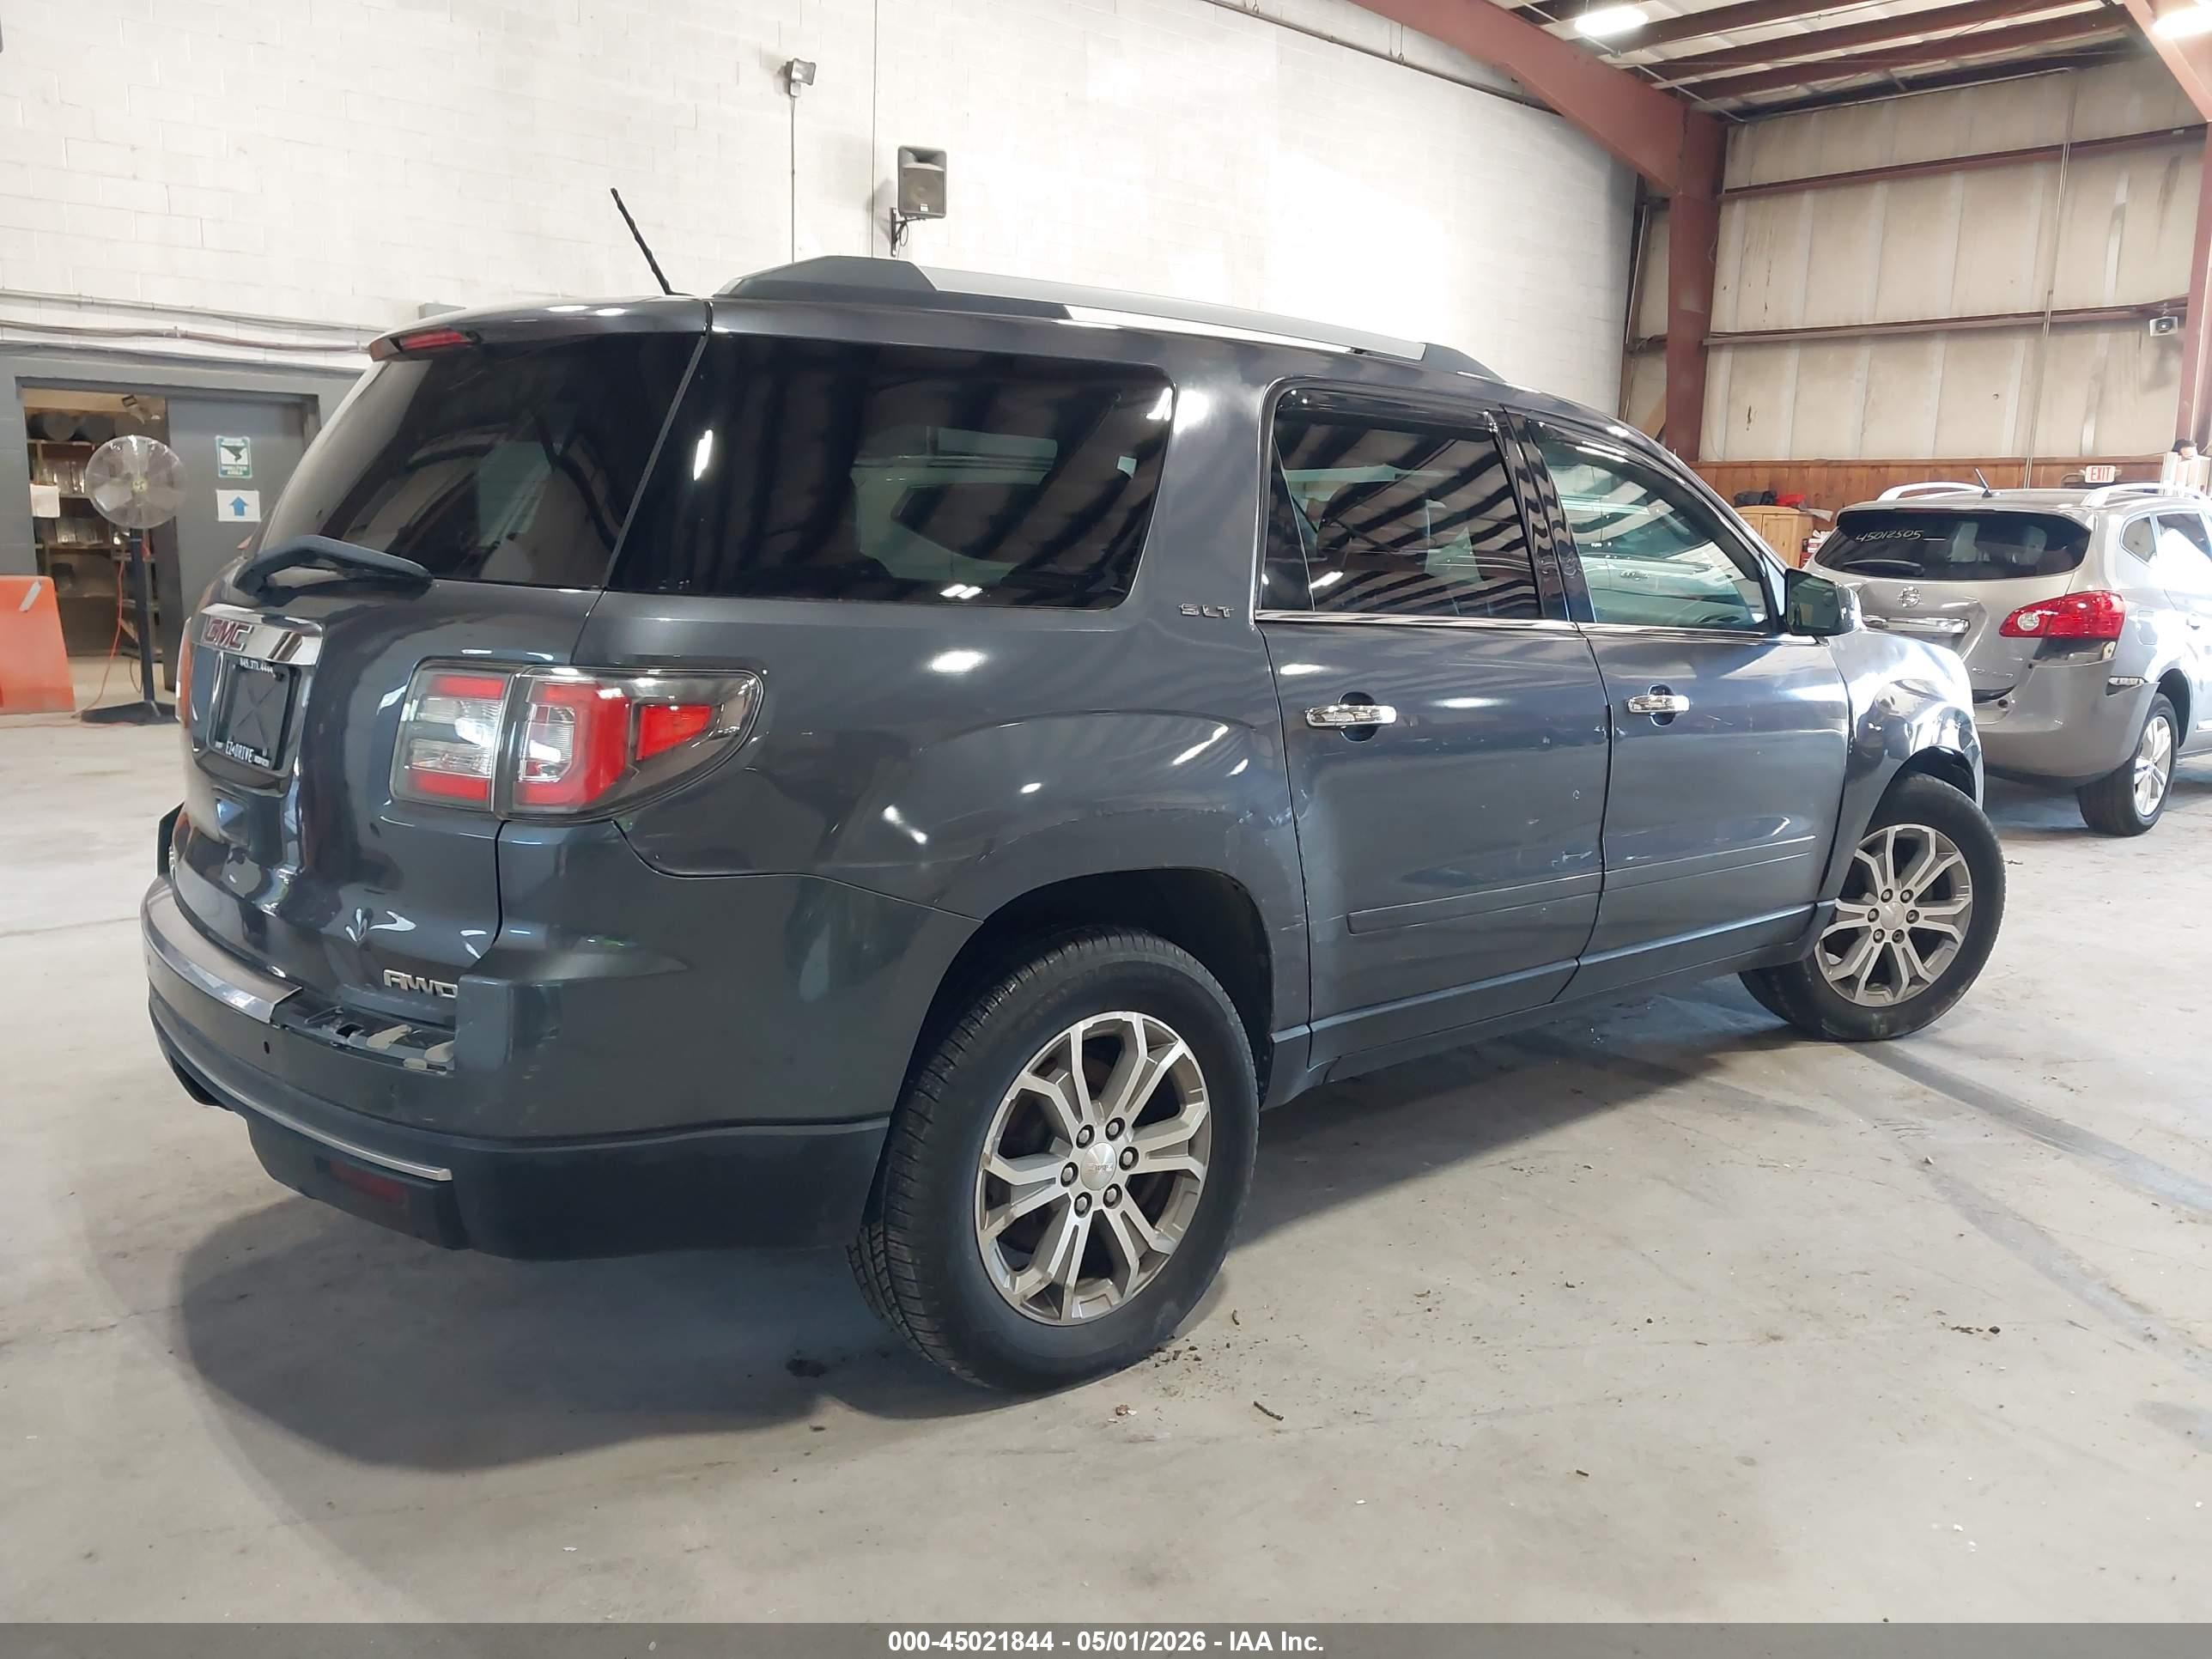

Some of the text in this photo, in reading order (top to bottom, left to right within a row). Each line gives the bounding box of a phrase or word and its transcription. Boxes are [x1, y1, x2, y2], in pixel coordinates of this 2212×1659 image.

[2090, 466, 2111, 482] EXIT
[1855, 529, 1924, 542] 45012505
[1181, 603, 1235, 617] SLT
[202, 617, 253, 652] GMC
[383, 969, 459, 999] AWD
